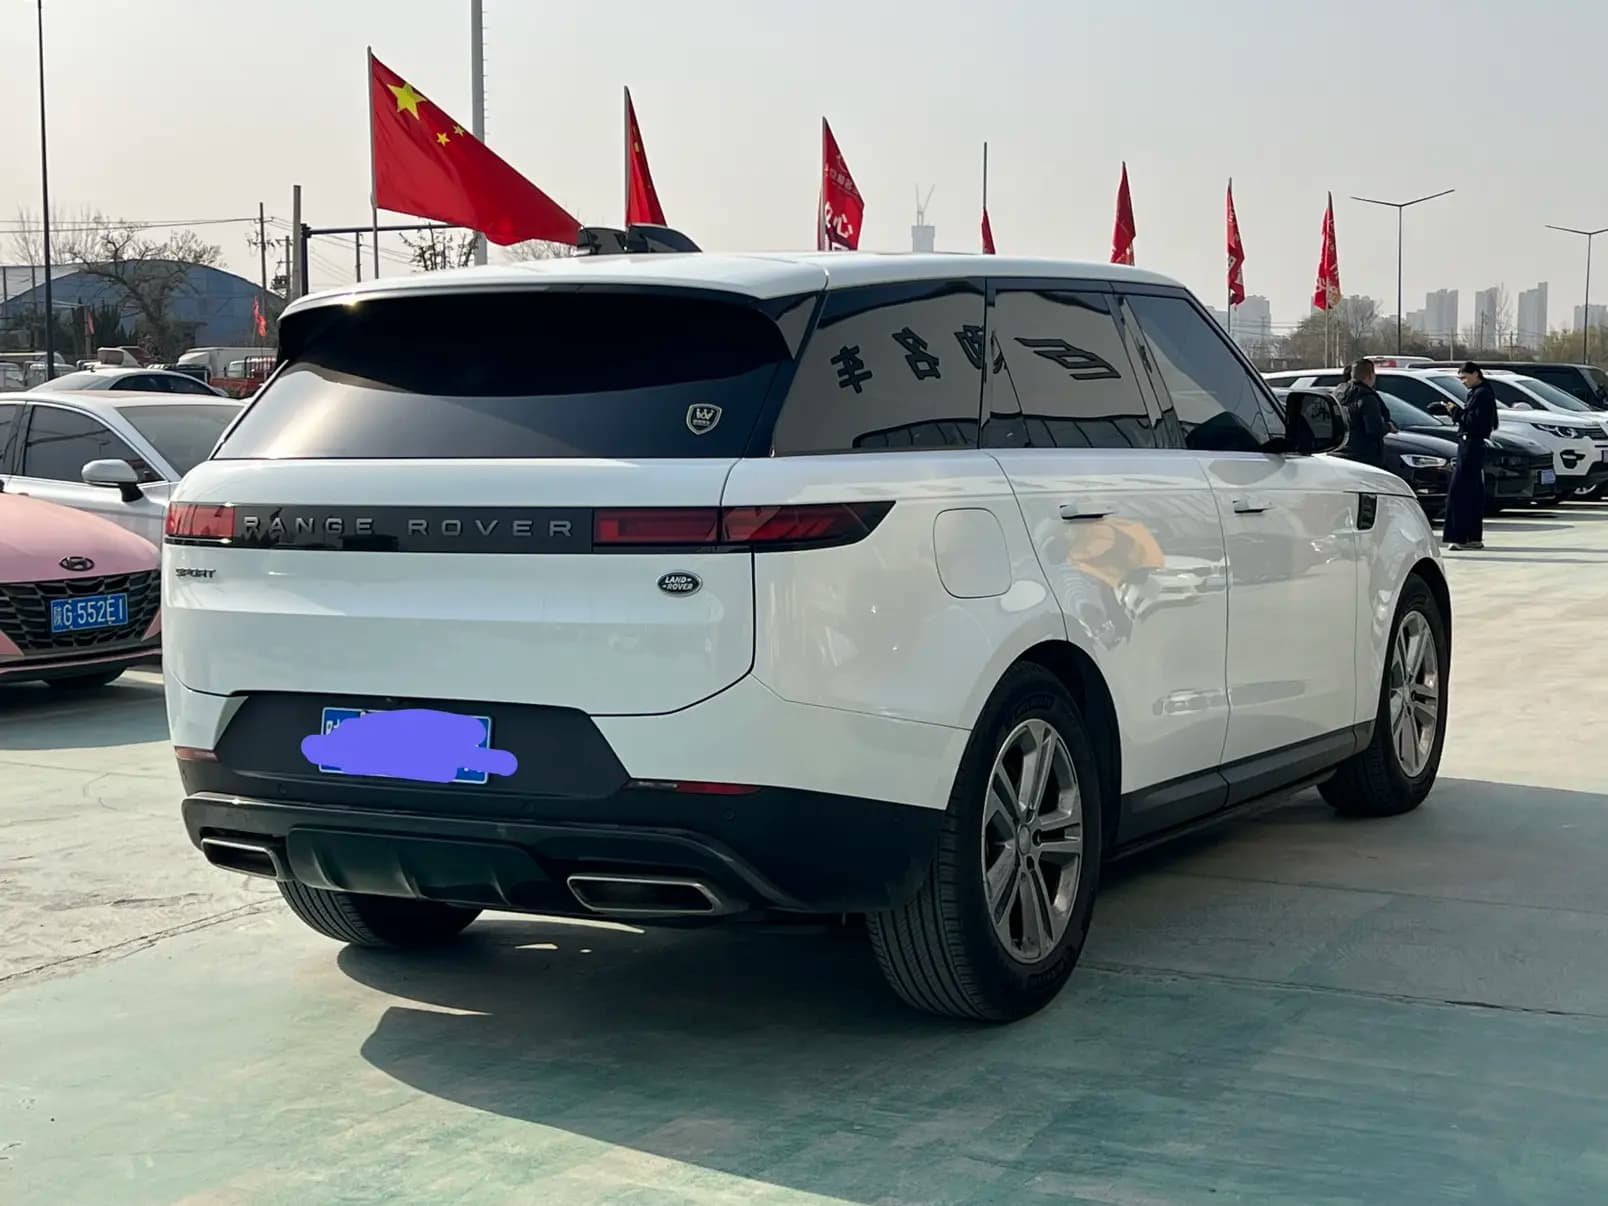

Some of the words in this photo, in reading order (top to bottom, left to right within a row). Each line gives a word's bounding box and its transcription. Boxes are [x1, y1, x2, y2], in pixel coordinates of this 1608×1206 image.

[243, 516, 374, 535] RANGE
[407, 519, 572, 537] ROVER
[664, 575, 687, 584] LAND
